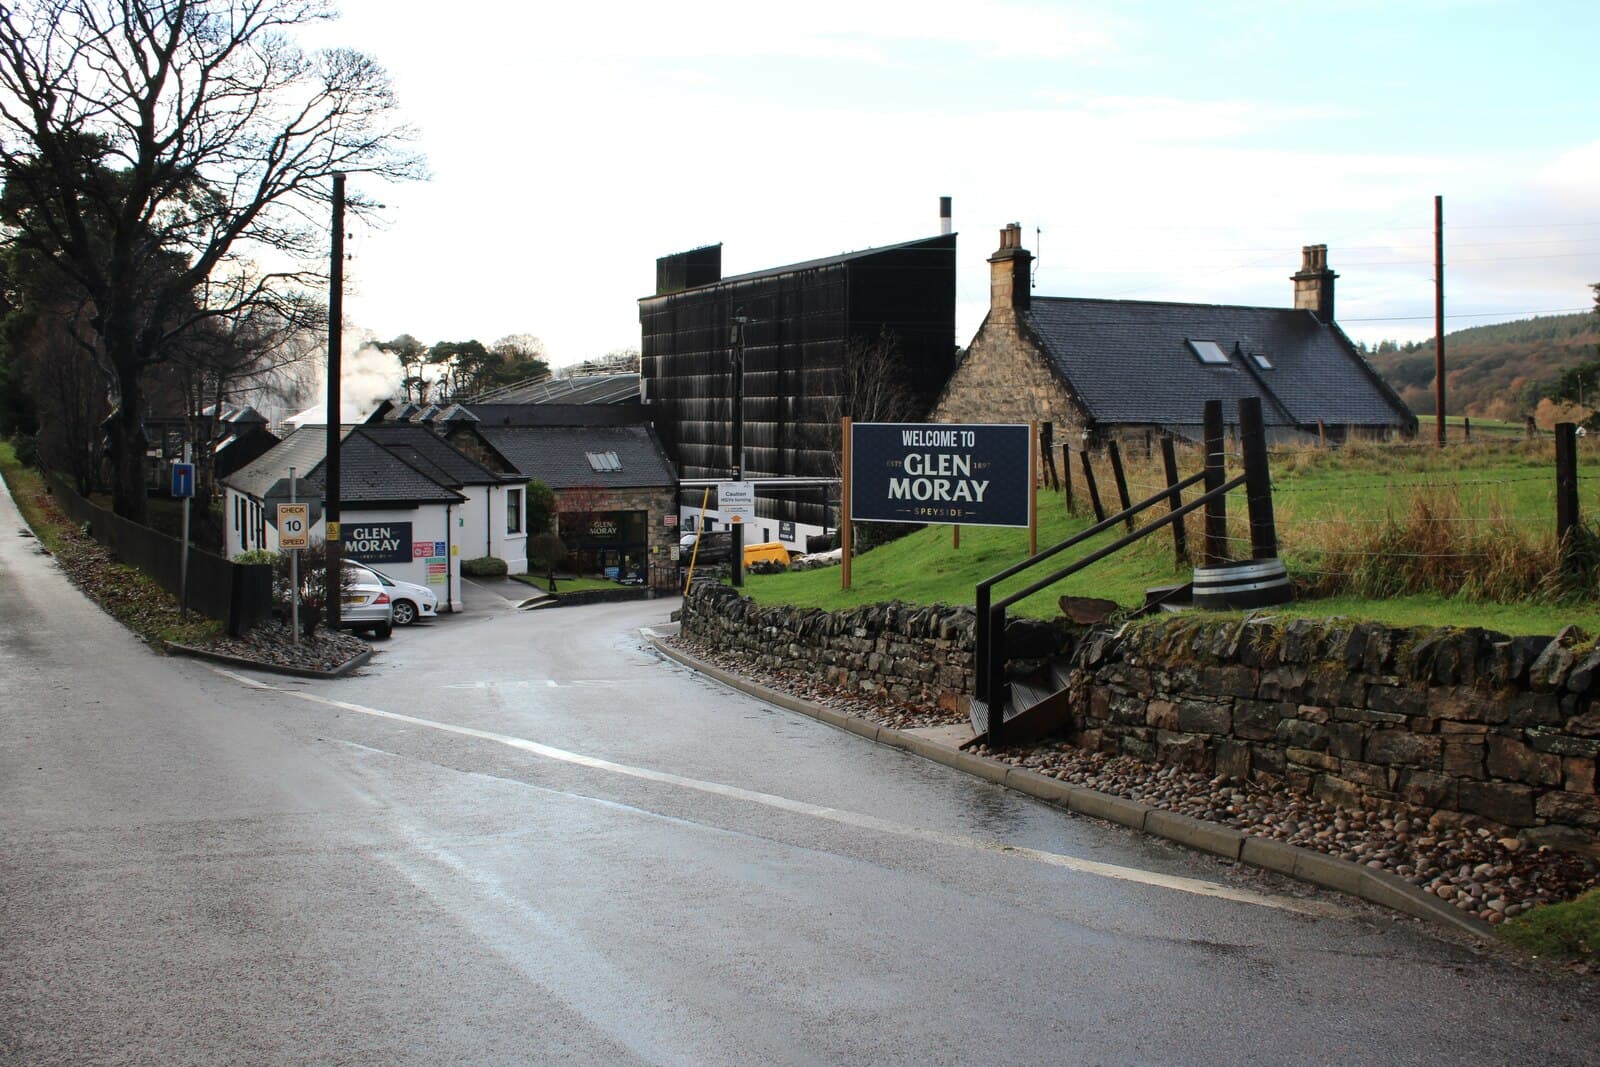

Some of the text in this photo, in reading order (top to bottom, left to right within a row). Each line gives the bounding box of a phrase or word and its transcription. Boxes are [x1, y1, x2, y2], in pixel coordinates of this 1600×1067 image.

[902, 430, 975, 447] WELCOME TO
[903, 453, 971, 477] GLEN
[887, 478, 989, 502] MORAY
[914, 507, 962, 517] SPEYSIDE
[285, 520, 302, 532] 10
[593, 520, 613, 528] GLEN
[353, 527, 391, 540] GLEN
[590, 527, 617, 536] MORAY
[282, 538, 305, 546] SPEED
[344, 539, 400, 552] MORAY
